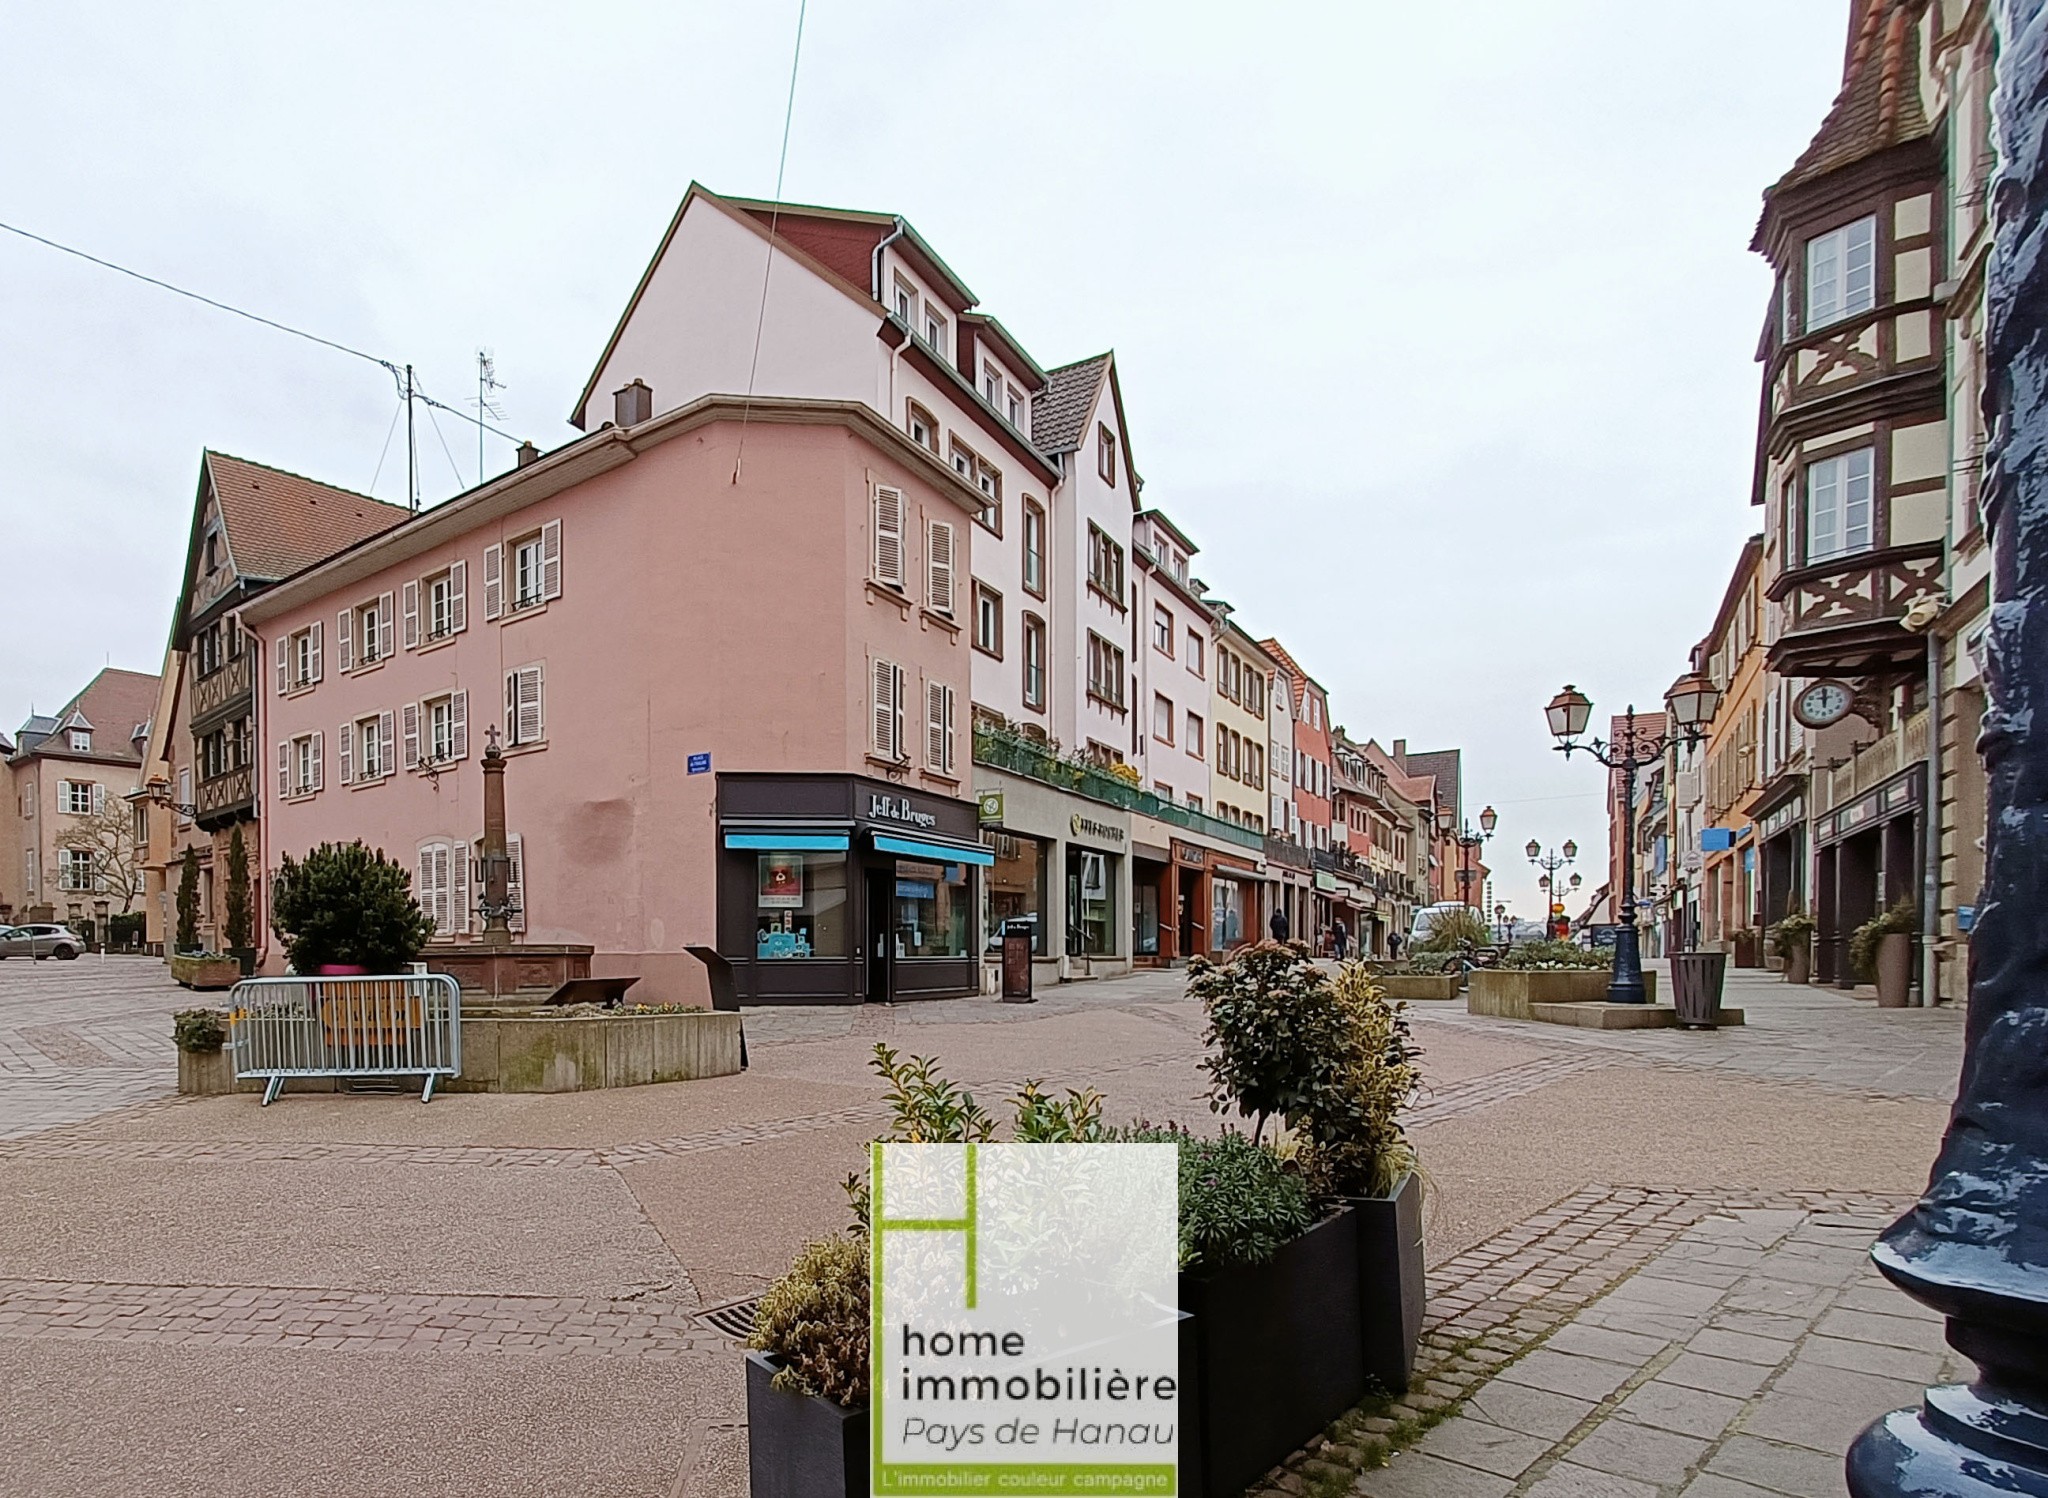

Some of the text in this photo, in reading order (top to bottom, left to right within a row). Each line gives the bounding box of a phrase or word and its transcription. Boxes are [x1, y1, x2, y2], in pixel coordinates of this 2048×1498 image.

[869, 795, 936, 828] Jeff de Bruges
